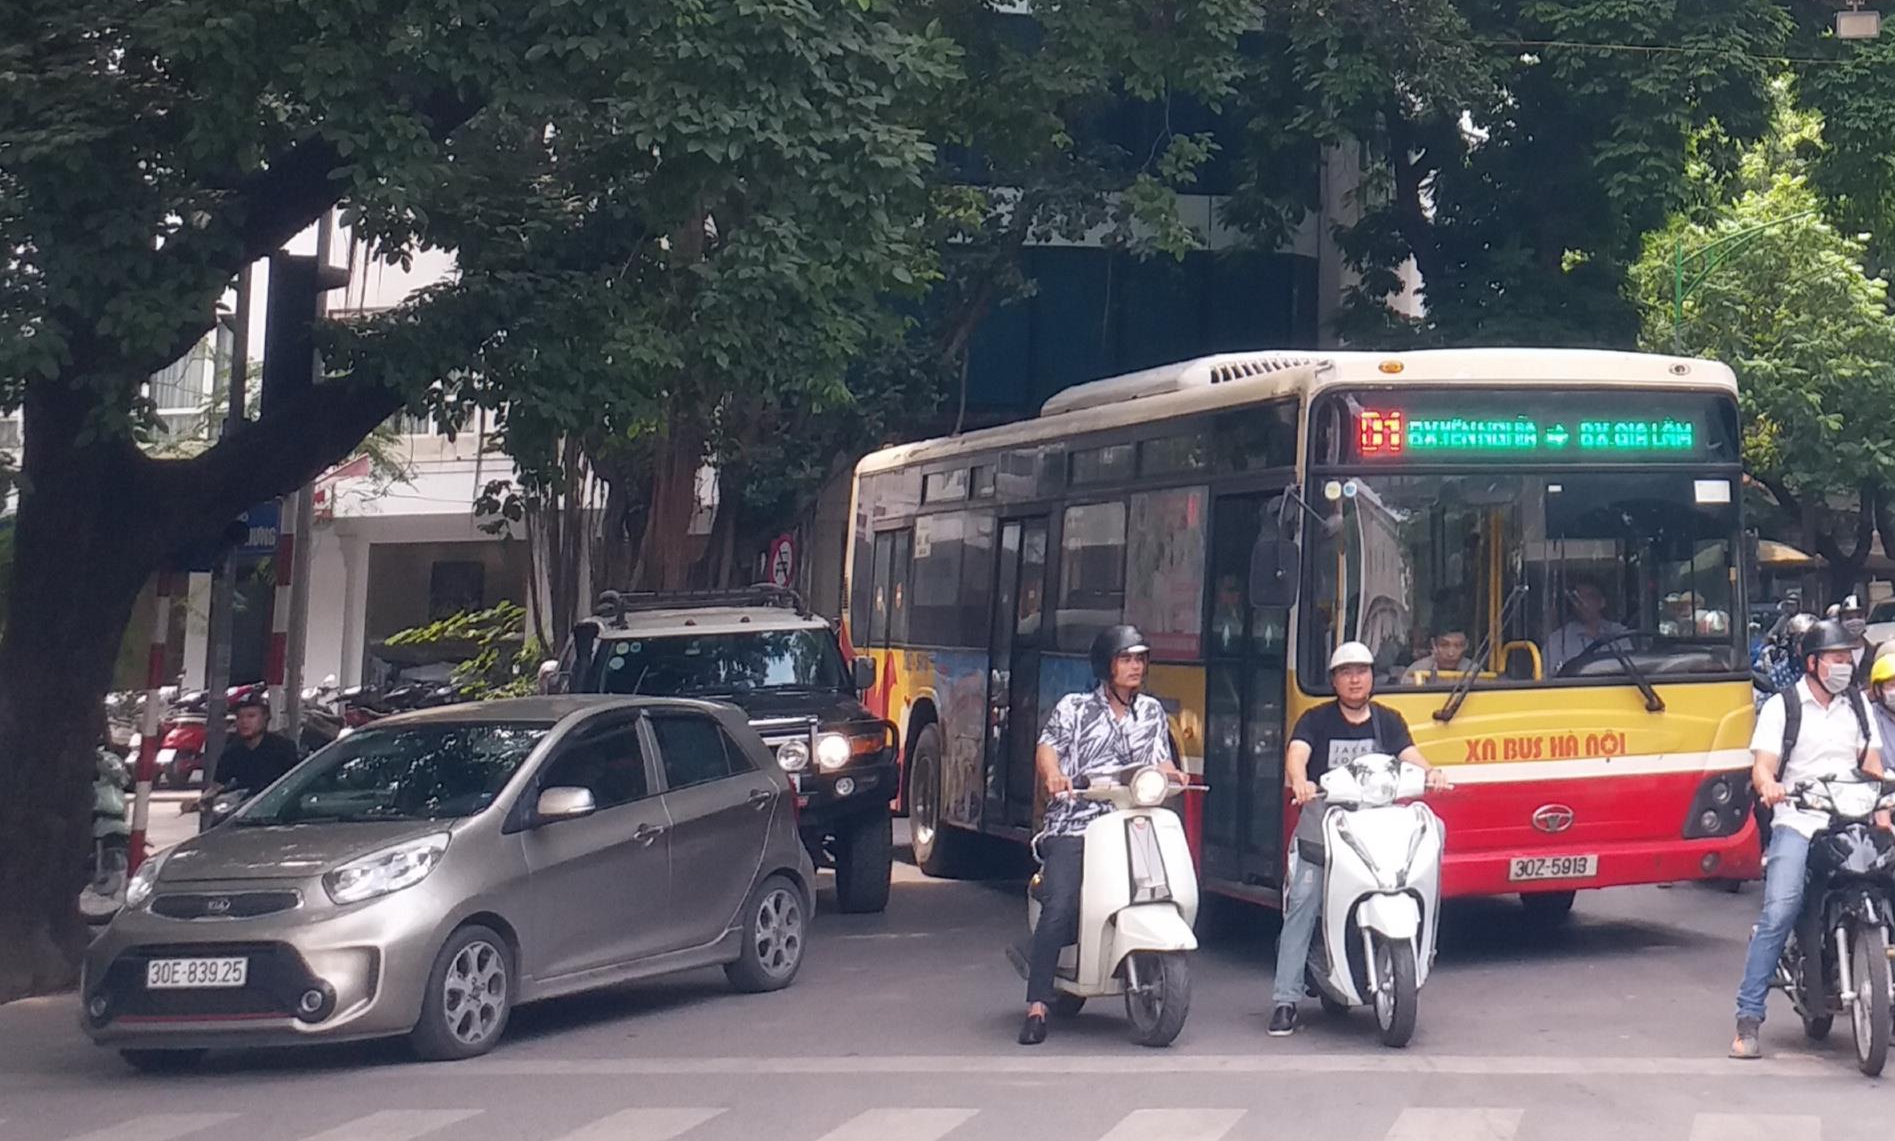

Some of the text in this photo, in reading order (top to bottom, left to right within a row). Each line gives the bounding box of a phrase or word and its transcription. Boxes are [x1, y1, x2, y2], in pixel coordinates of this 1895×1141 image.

[1503, 736, 1544, 760] BUS
[1550, 729, 1579, 758] HÀ
[1514, 856, 1588, 878] 30Z-5913
[150, 960, 243, 985] 30E-839.25
